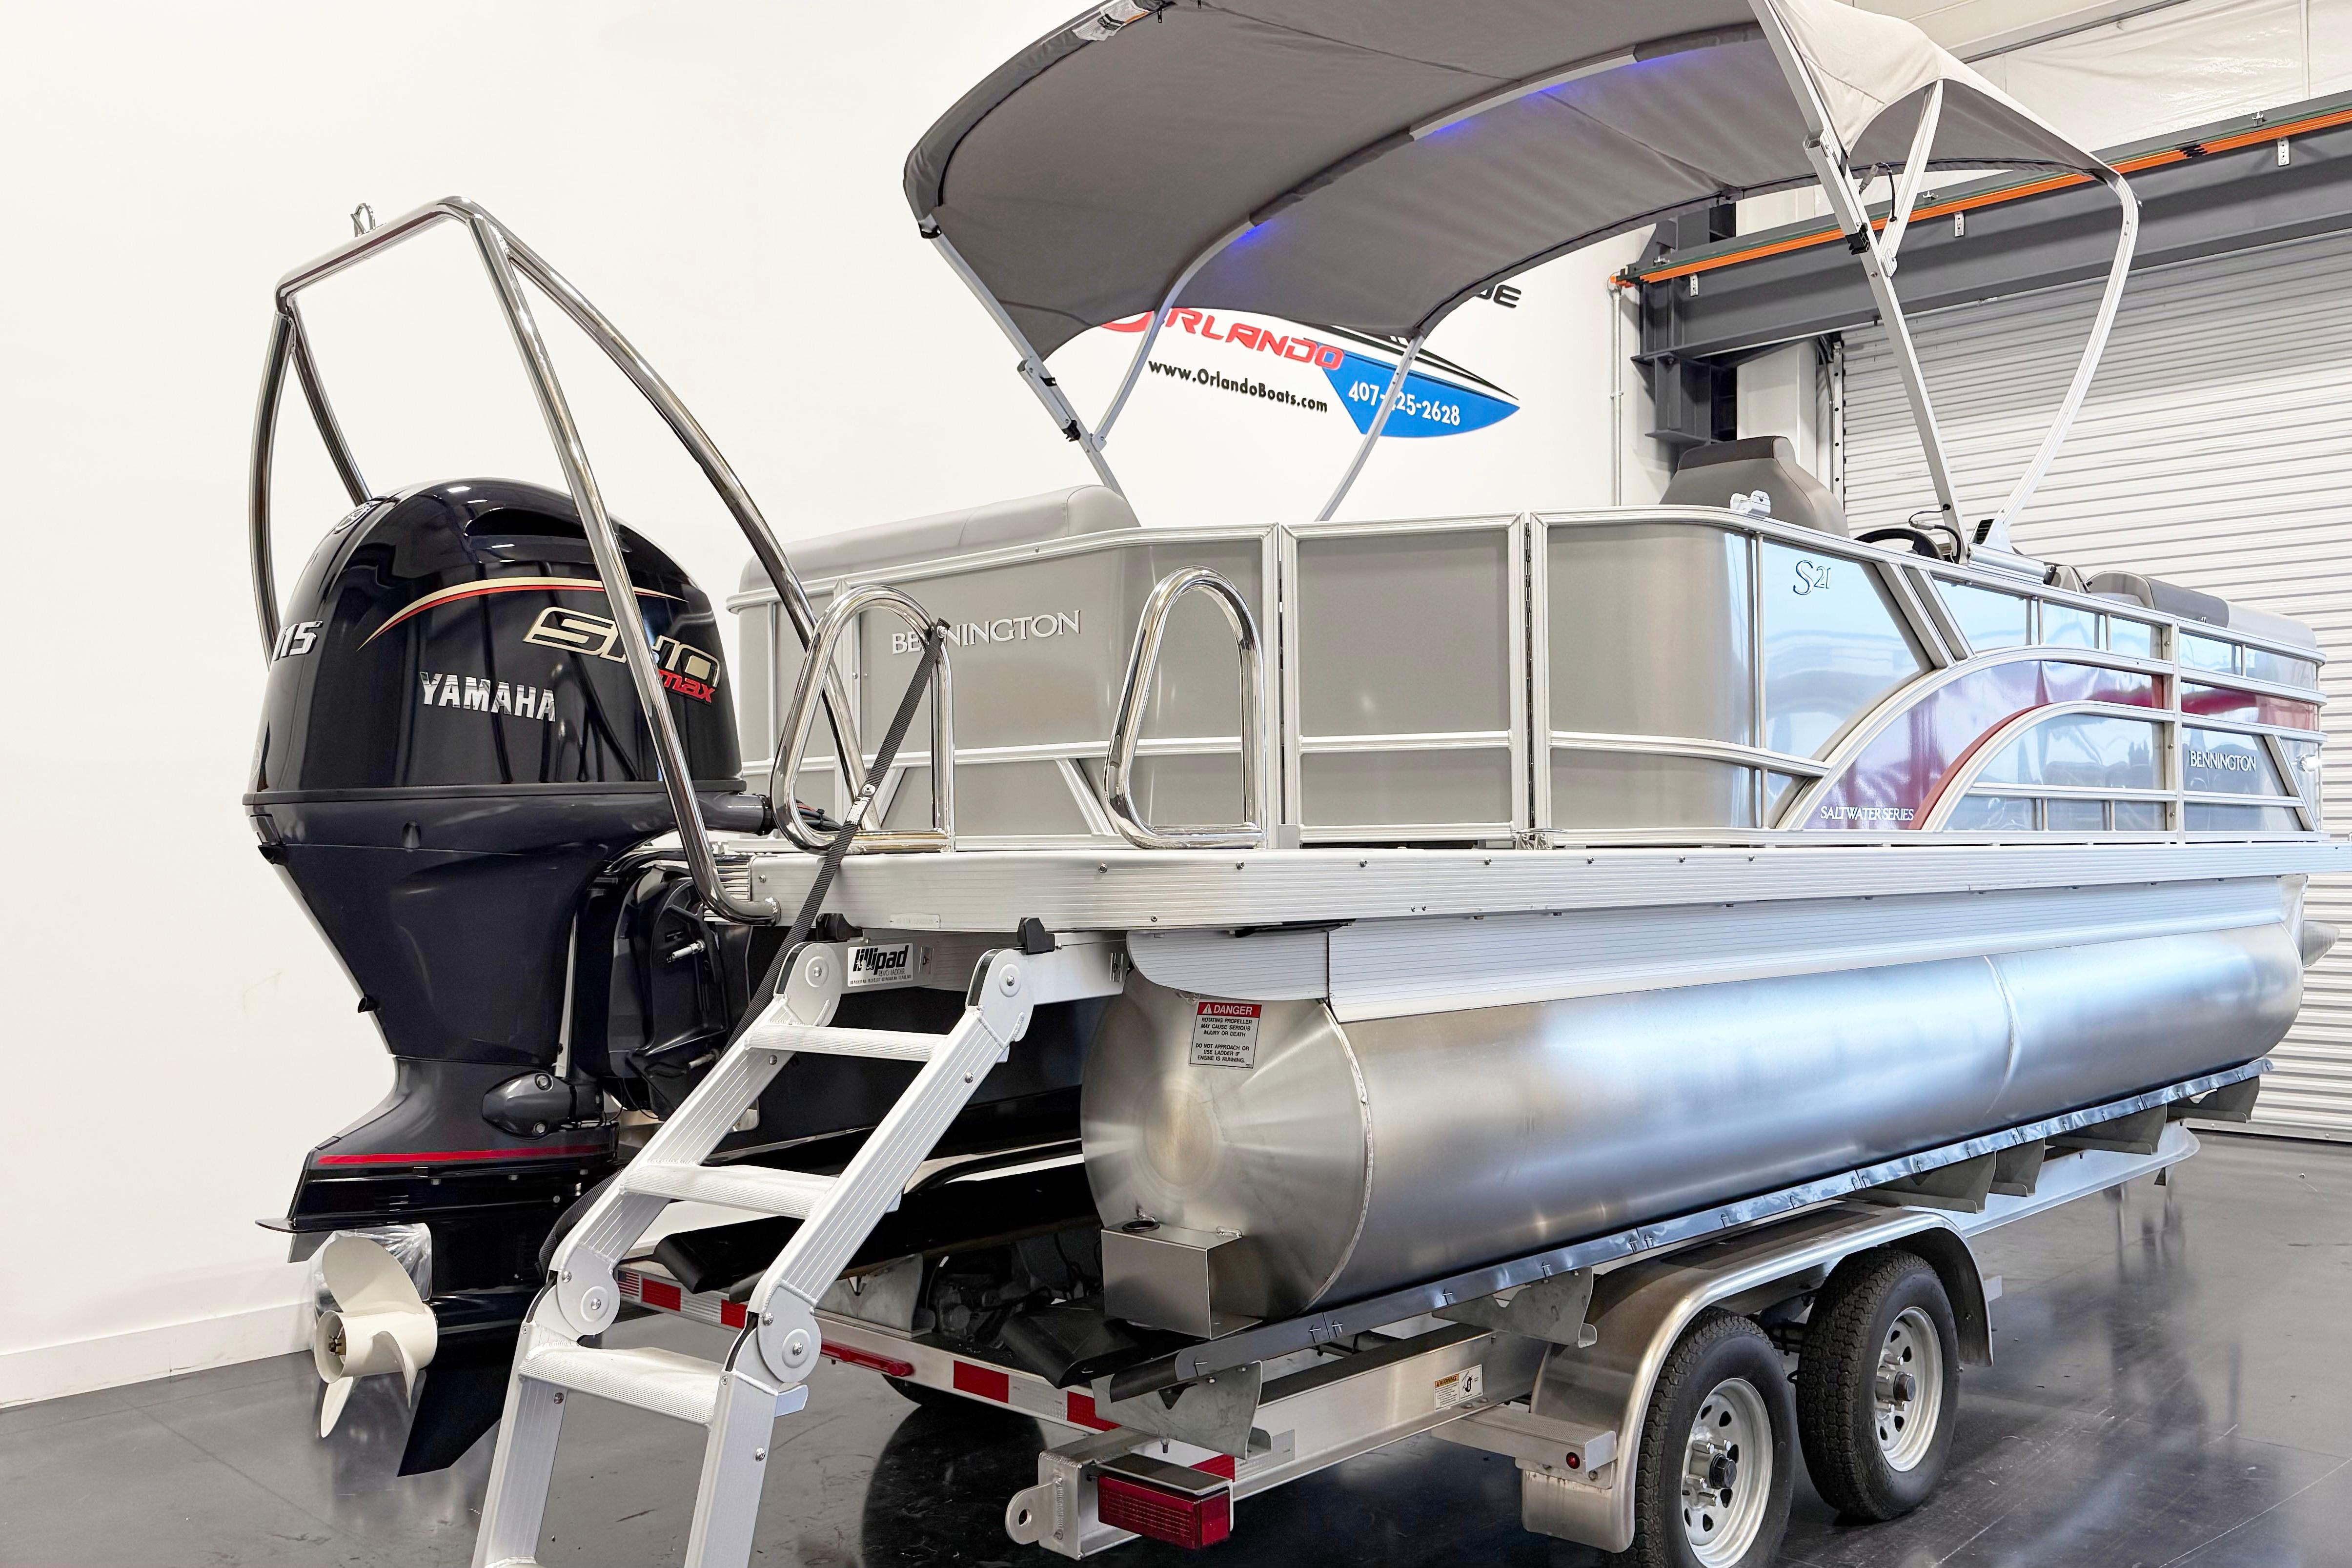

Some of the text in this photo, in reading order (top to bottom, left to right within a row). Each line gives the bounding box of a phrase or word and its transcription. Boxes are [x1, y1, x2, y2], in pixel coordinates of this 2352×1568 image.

[1148, 360, 1327, 413] www.OrlandoBoats.com
[1348, 381, 1460, 426] 407-25-2628
[1793, 560, 1831, 595] S21
[892, 610, 1081, 655] BENINGTON
[419, 672, 556, 722] YAMAHA
[2189, 750, 2256, 772] BENNINGTON
[1882, 807, 1914, 821] SERIES
[1214, 1005, 1253, 1016] DANGER
